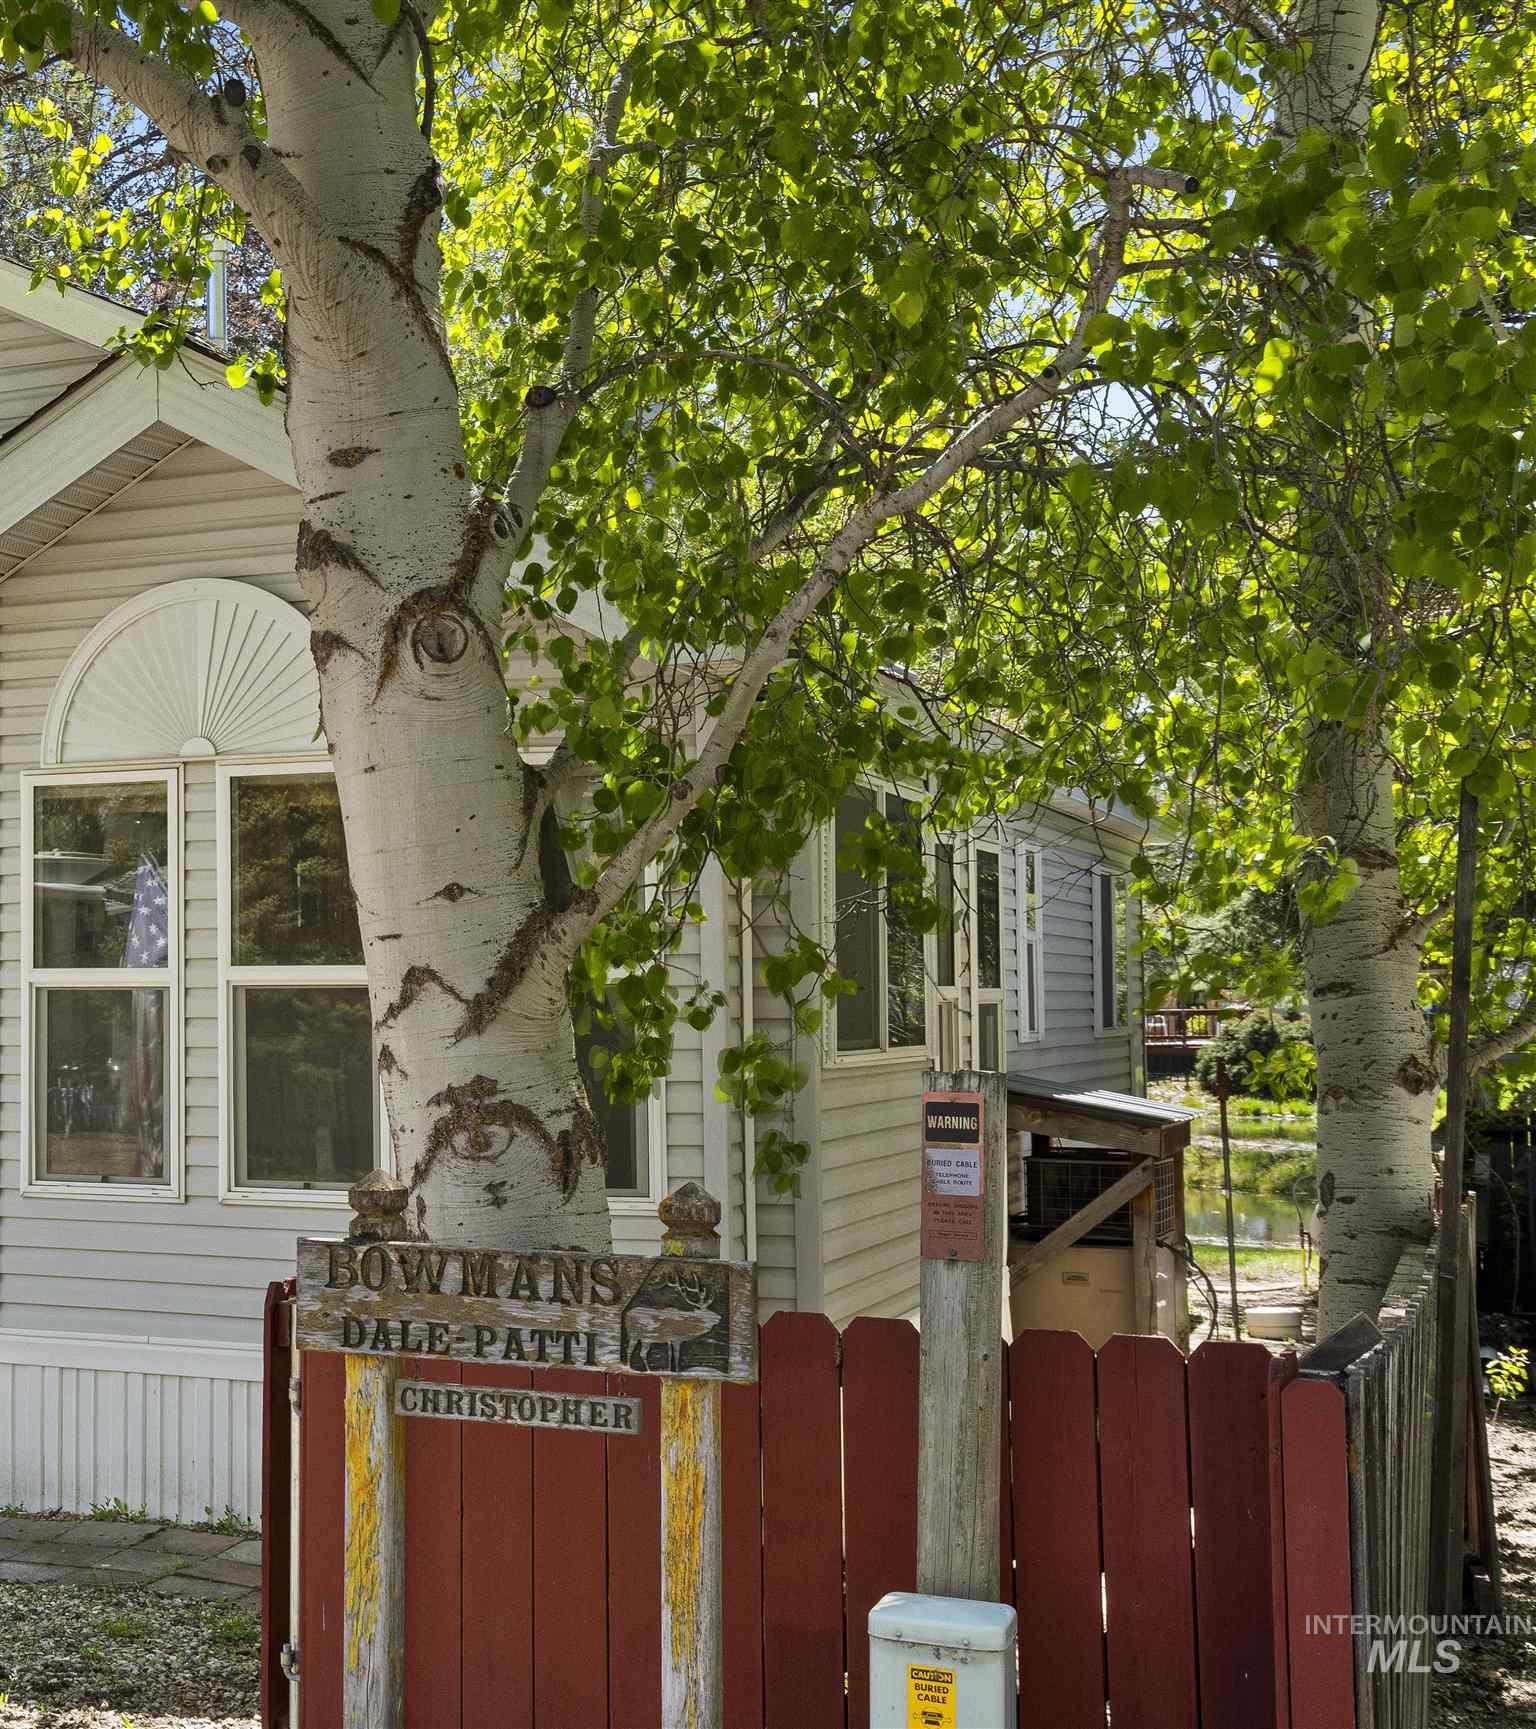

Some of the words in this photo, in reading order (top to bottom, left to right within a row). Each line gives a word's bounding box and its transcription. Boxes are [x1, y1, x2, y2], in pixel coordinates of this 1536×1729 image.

[927, 1115, 978, 1130] WARNING
[955, 1160, 978, 1168] CABLE
[324, 1243, 623, 1305] BOWMANS
[342, 1316, 451, 1354] DALE
[473, 1325, 599, 1367] PATTI
[400, 1385, 634, 1431] CHRISTOPHER
[914, 1683, 949, 1694] BURIED
[917, 1693, 947, 1704] CABLE
